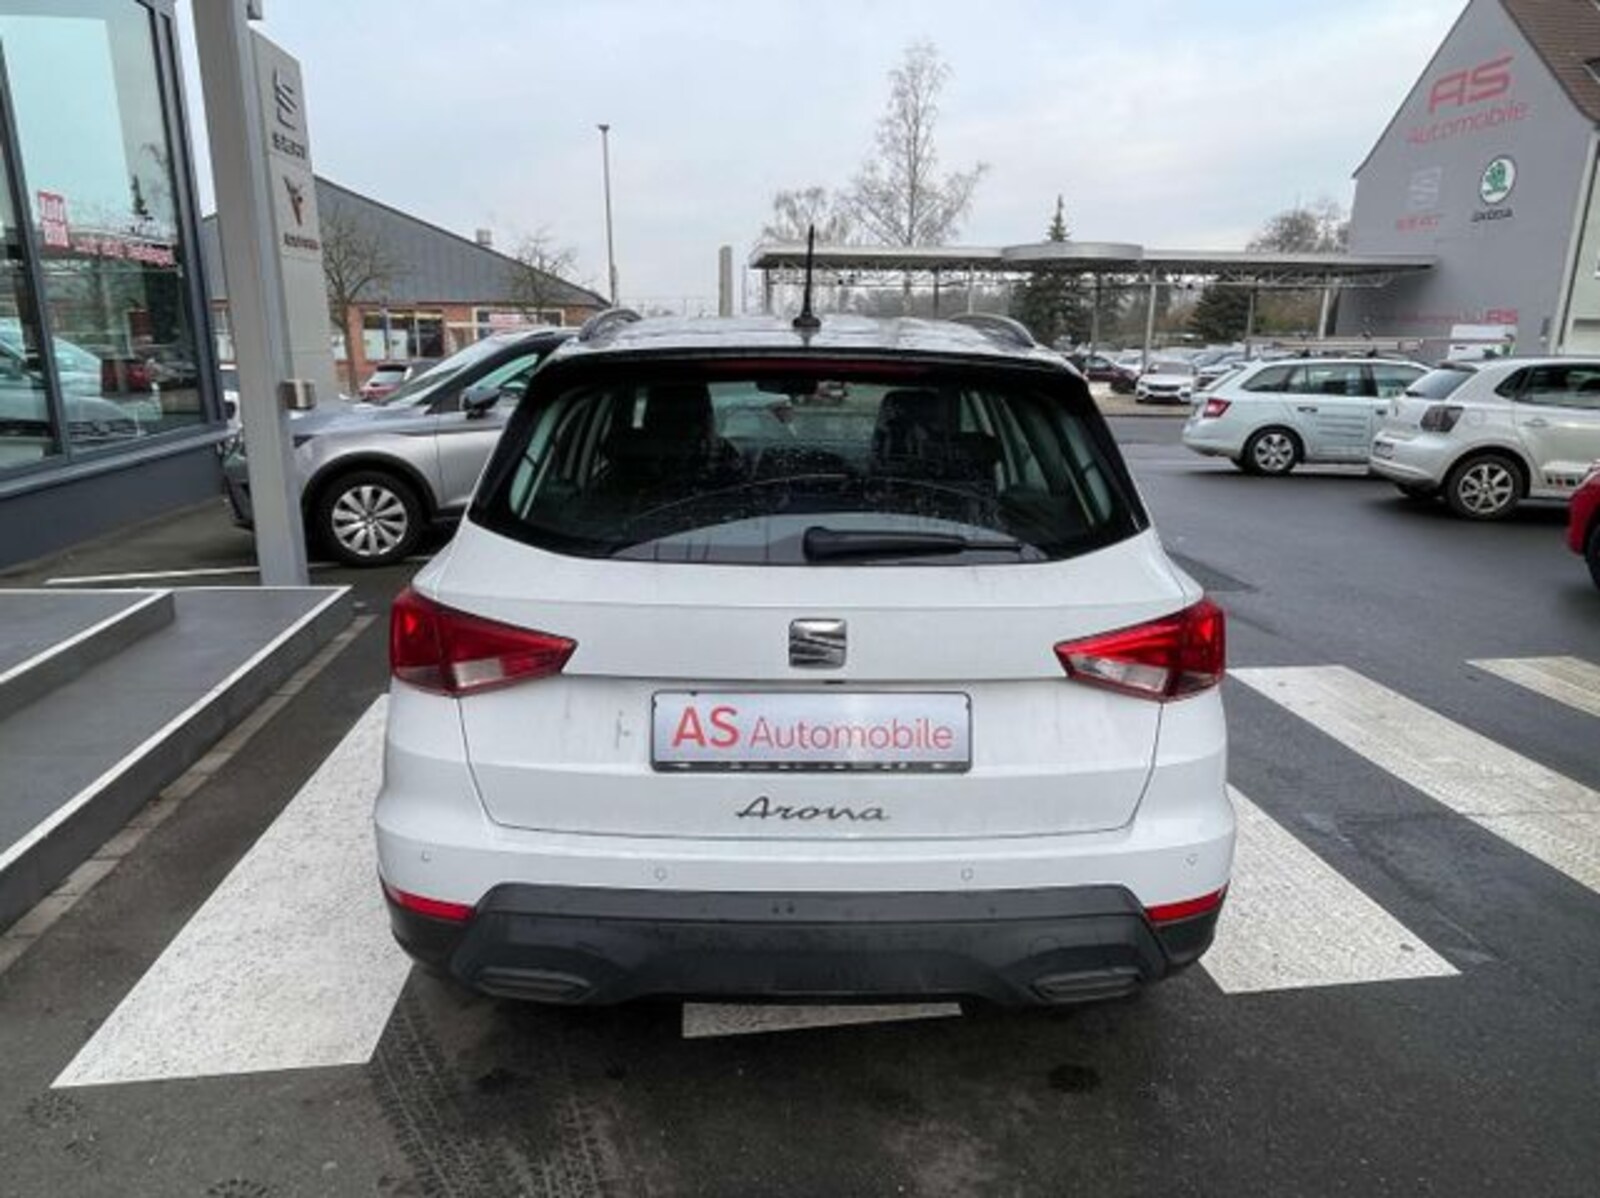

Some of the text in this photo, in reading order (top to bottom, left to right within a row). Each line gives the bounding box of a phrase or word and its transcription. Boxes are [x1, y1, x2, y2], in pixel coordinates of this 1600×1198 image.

[1428, 54, 1515, 113] AS
[671, 707, 953, 750] AS Automobile
[735, 796, 890, 821] Arona
